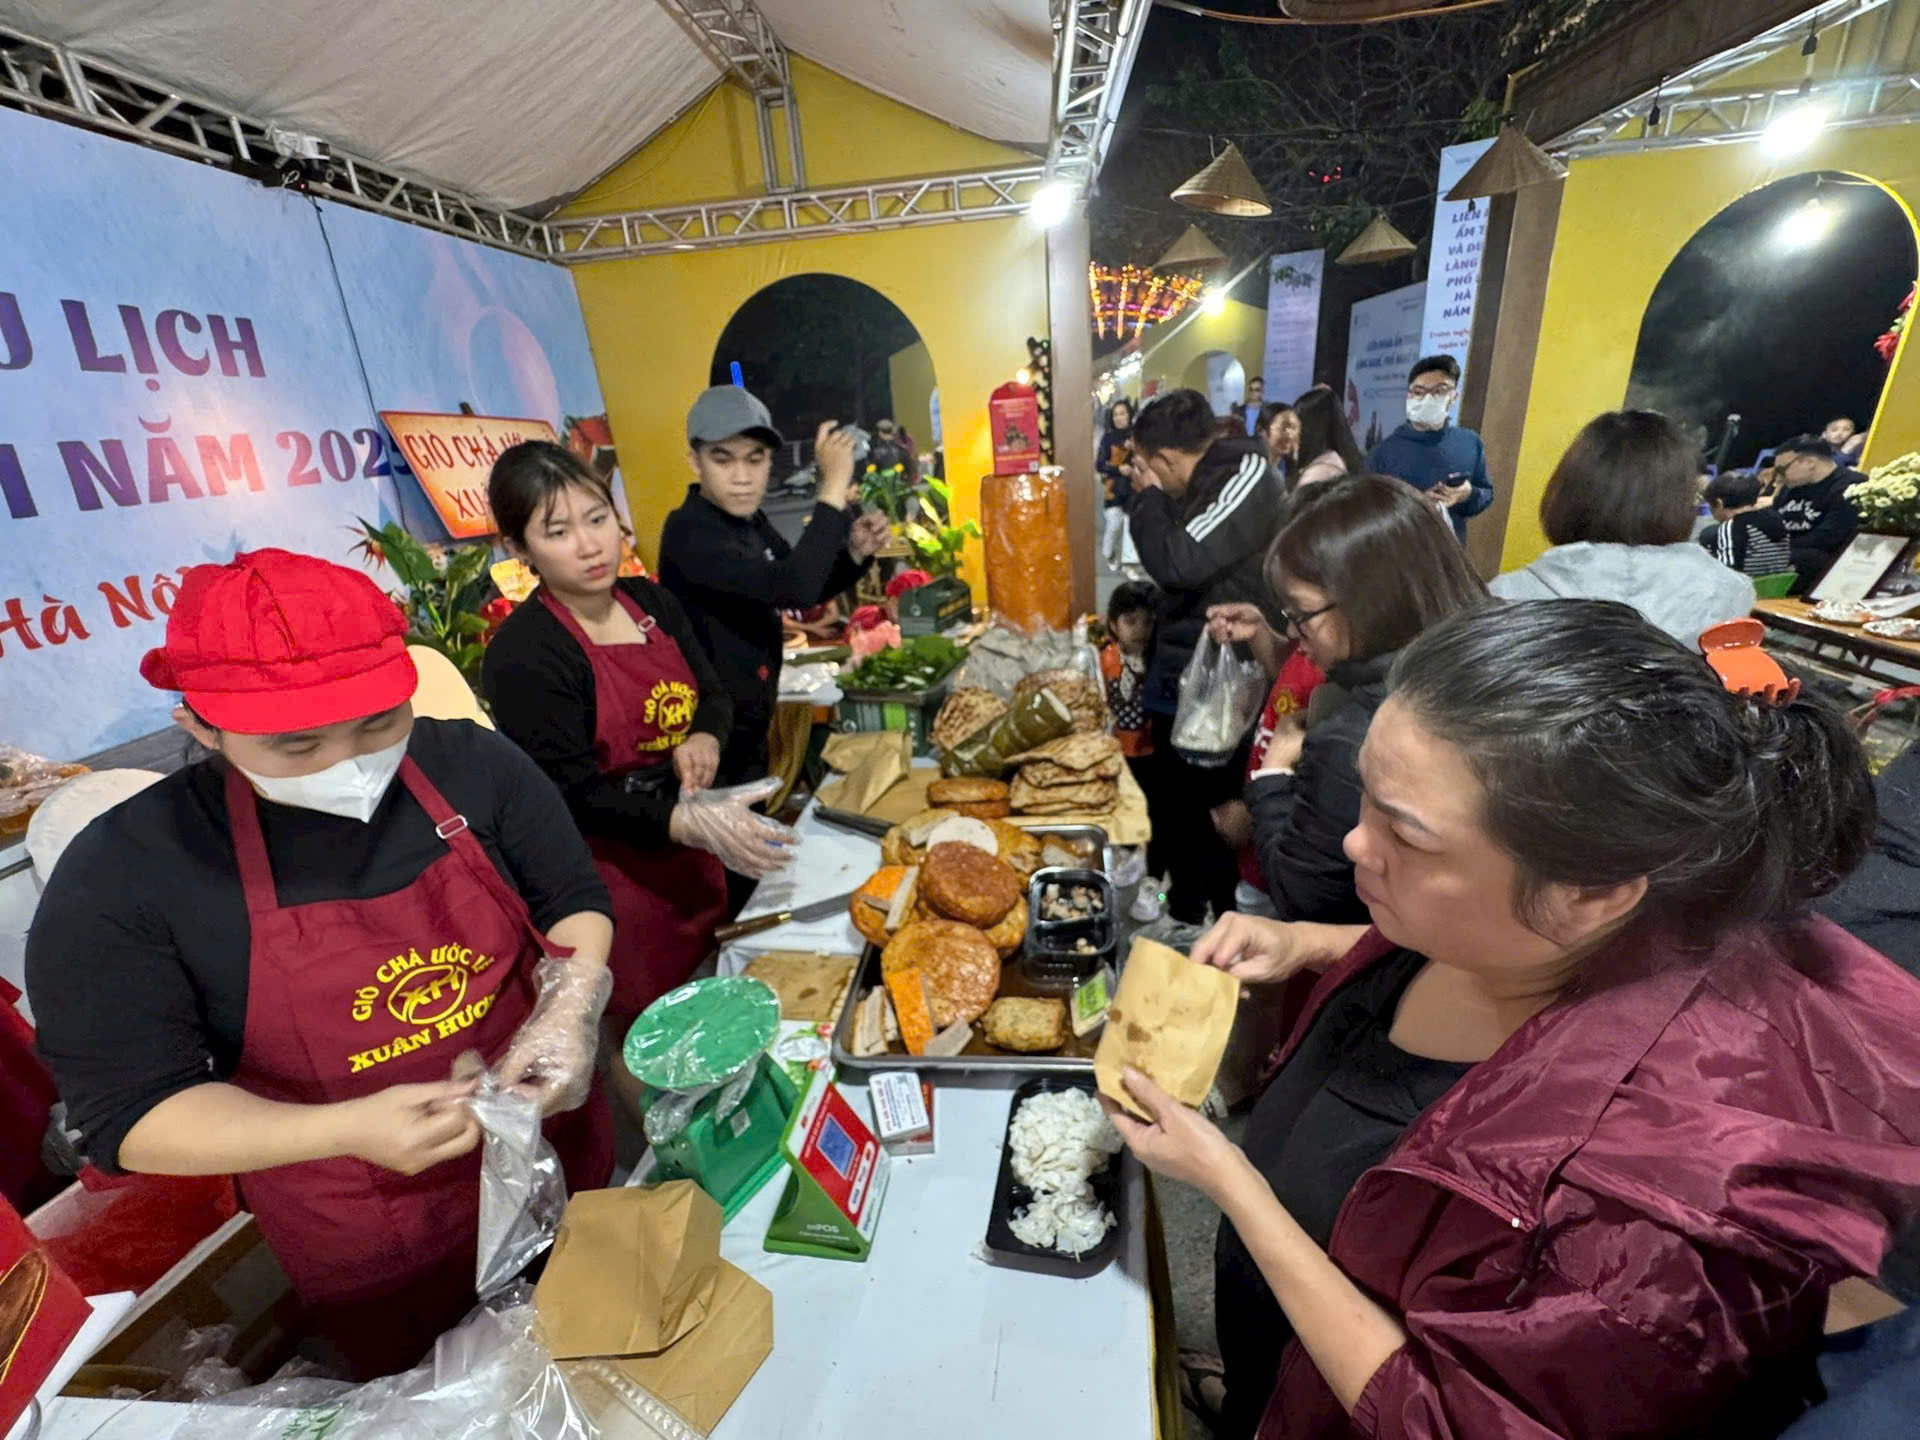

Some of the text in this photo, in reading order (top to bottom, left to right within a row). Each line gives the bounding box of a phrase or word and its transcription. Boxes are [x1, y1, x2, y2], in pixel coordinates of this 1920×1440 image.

[60, 298, 267, 392] LỊCH
[57, 413, 265, 511] NĂM
[404, 428, 455, 472] GIÒ
[452, 424, 500, 469] CHẢ
[352, 985, 380, 1022] GIÒ
[376, 947, 426, 984] CHẢ
[430, 942, 473, 965] ƯỚC
[348, 1027, 432, 1074] XUÂN
